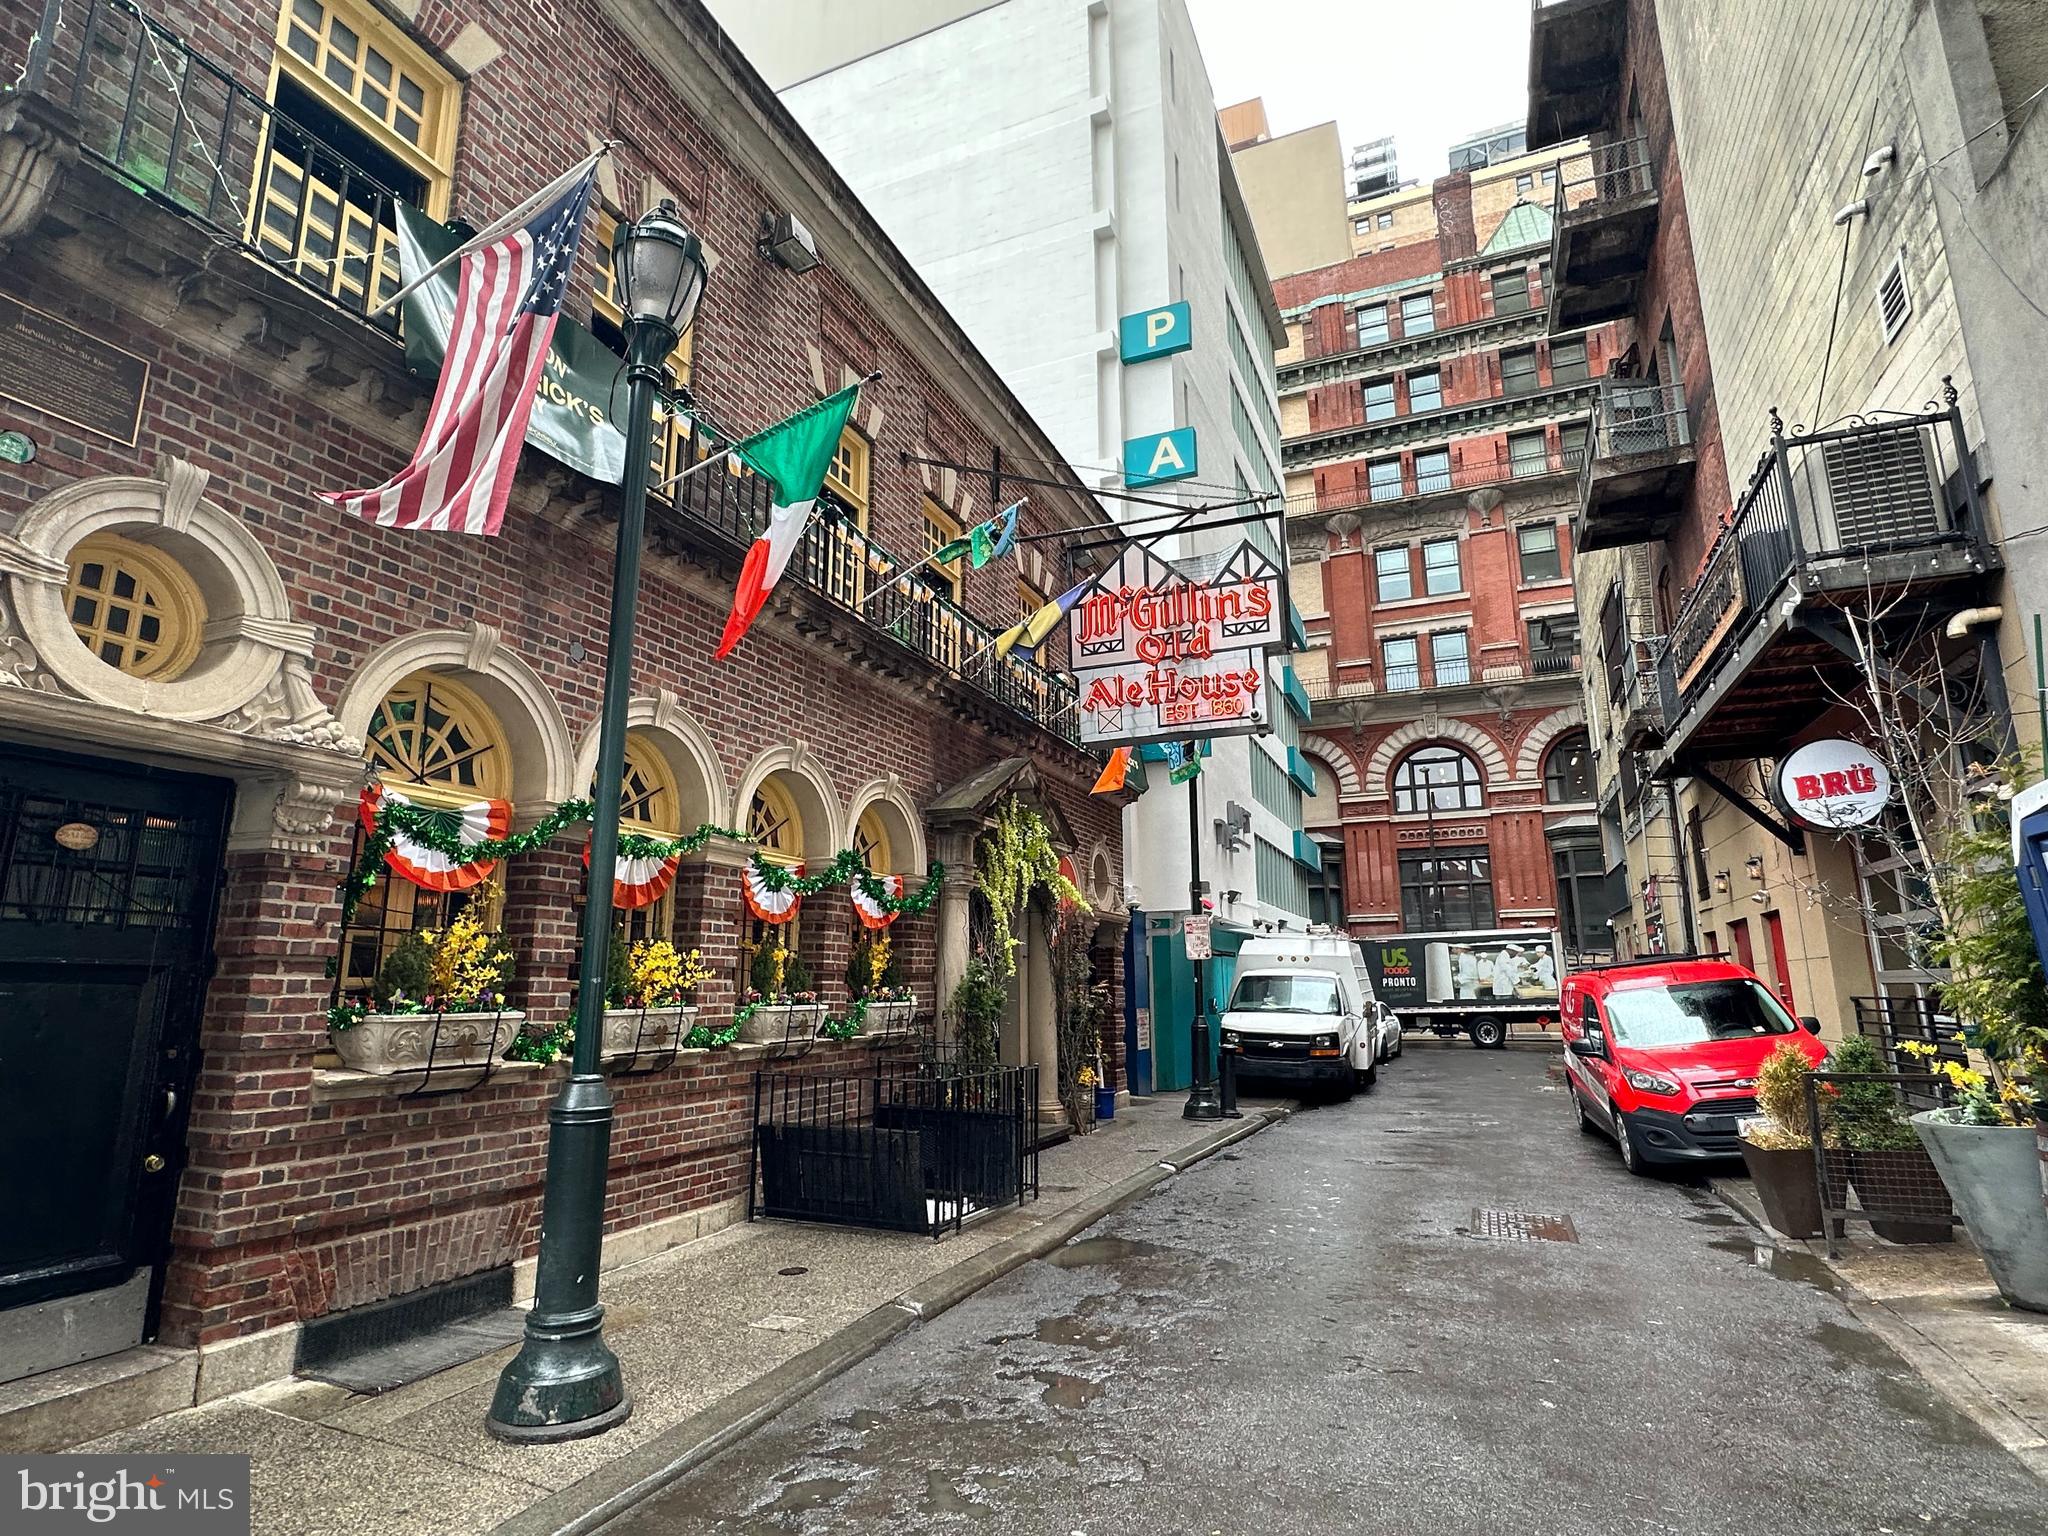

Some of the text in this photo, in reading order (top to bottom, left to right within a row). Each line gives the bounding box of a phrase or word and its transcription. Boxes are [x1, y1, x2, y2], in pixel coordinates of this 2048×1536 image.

[1147, 311, 1175, 348] P
[1148, 436, 1186, 475] A
[1136, 623, 1213, 666] Old
[1792, 762, 1877, 802] BRÜ
[1382, 976, 1417, 988] PRONTO
[1383, 966, 1410, 975] FOODS
